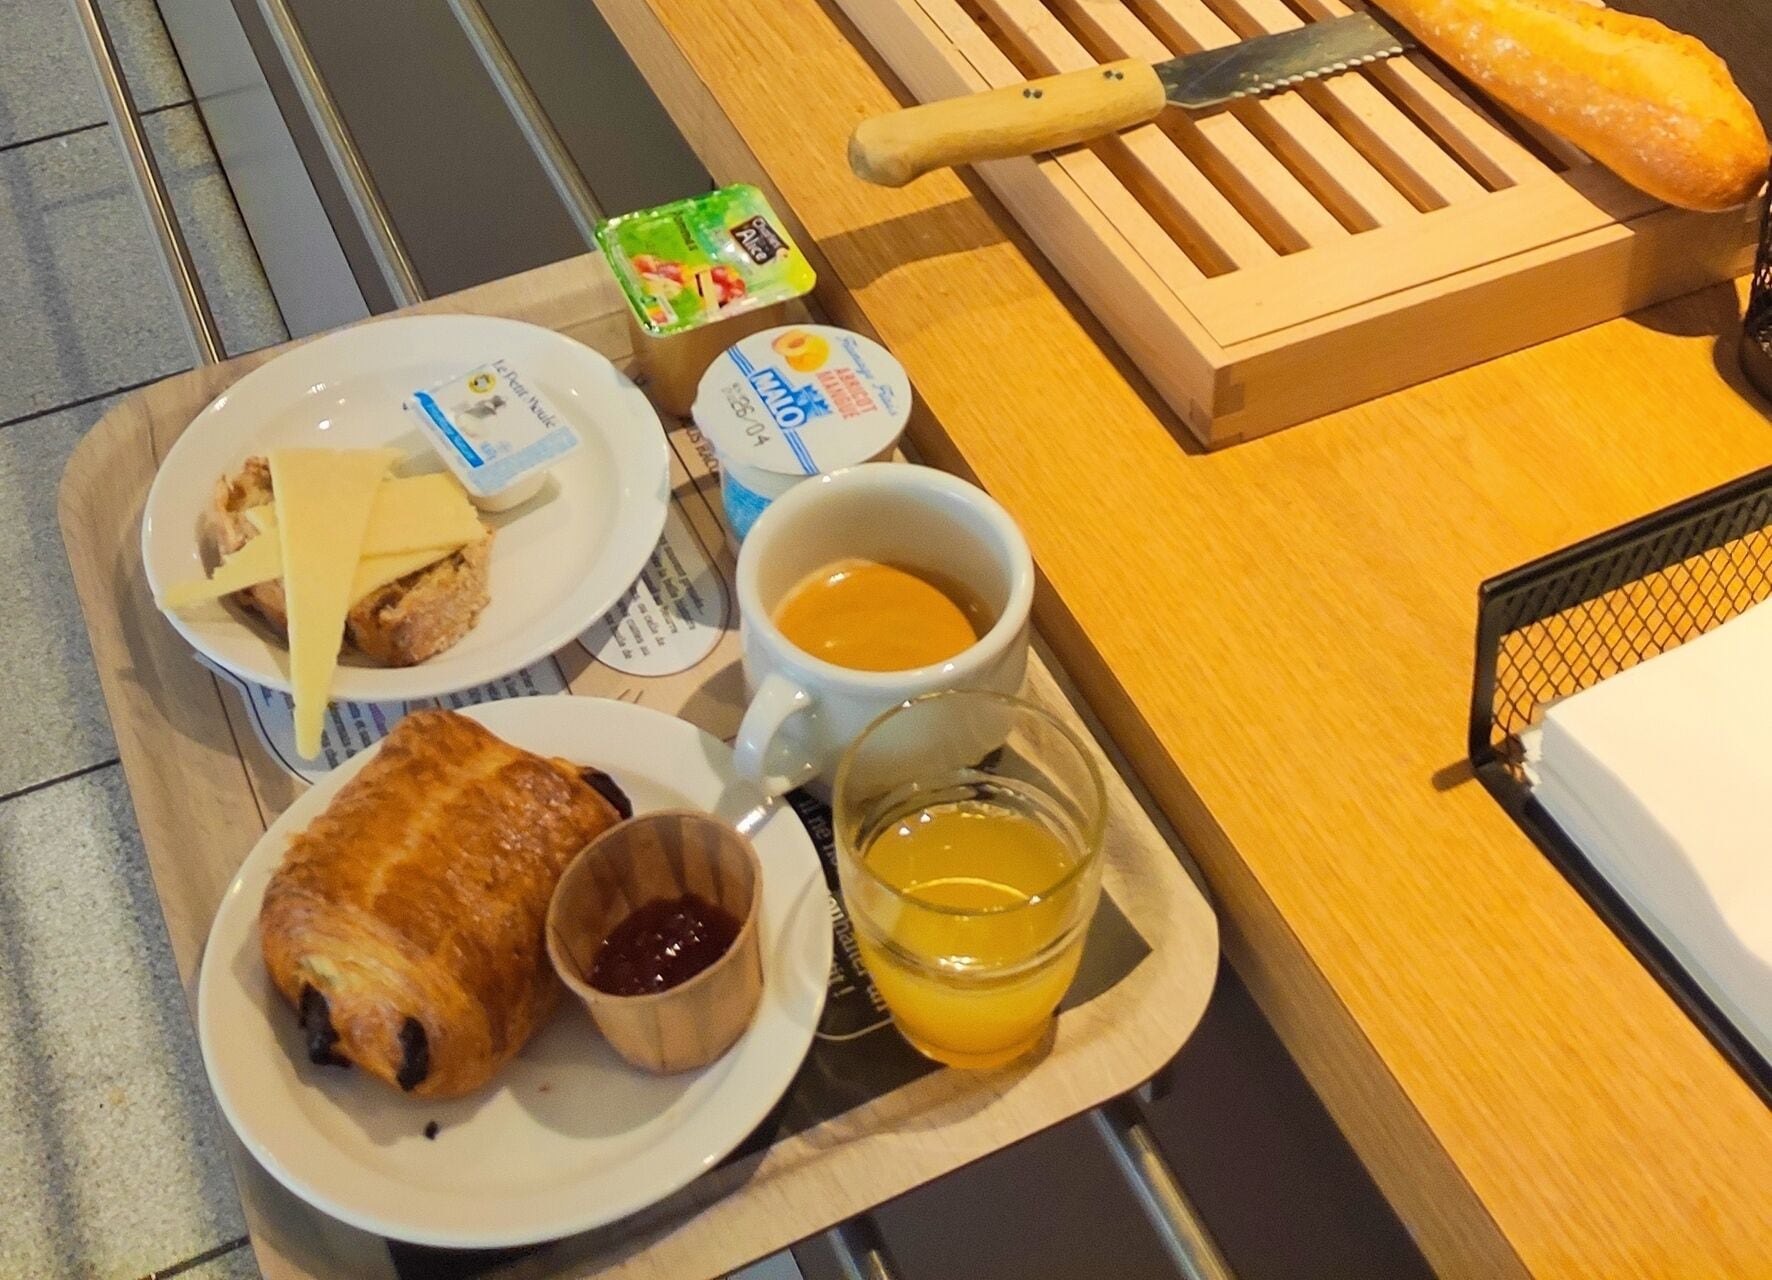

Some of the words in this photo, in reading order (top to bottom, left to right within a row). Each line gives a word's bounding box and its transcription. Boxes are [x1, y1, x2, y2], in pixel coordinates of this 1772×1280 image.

[735, 228, 768, 262] Alice
[491, 358, 508, 374] Le
[503, 369, 529, 399] Petit
[750, 369, 806, 430] MALO
[834, 367, 879, 413] ABRICOT
[729, 393, 771, 448] 26/04
[828, 894, 865, 977] ouhaiter
